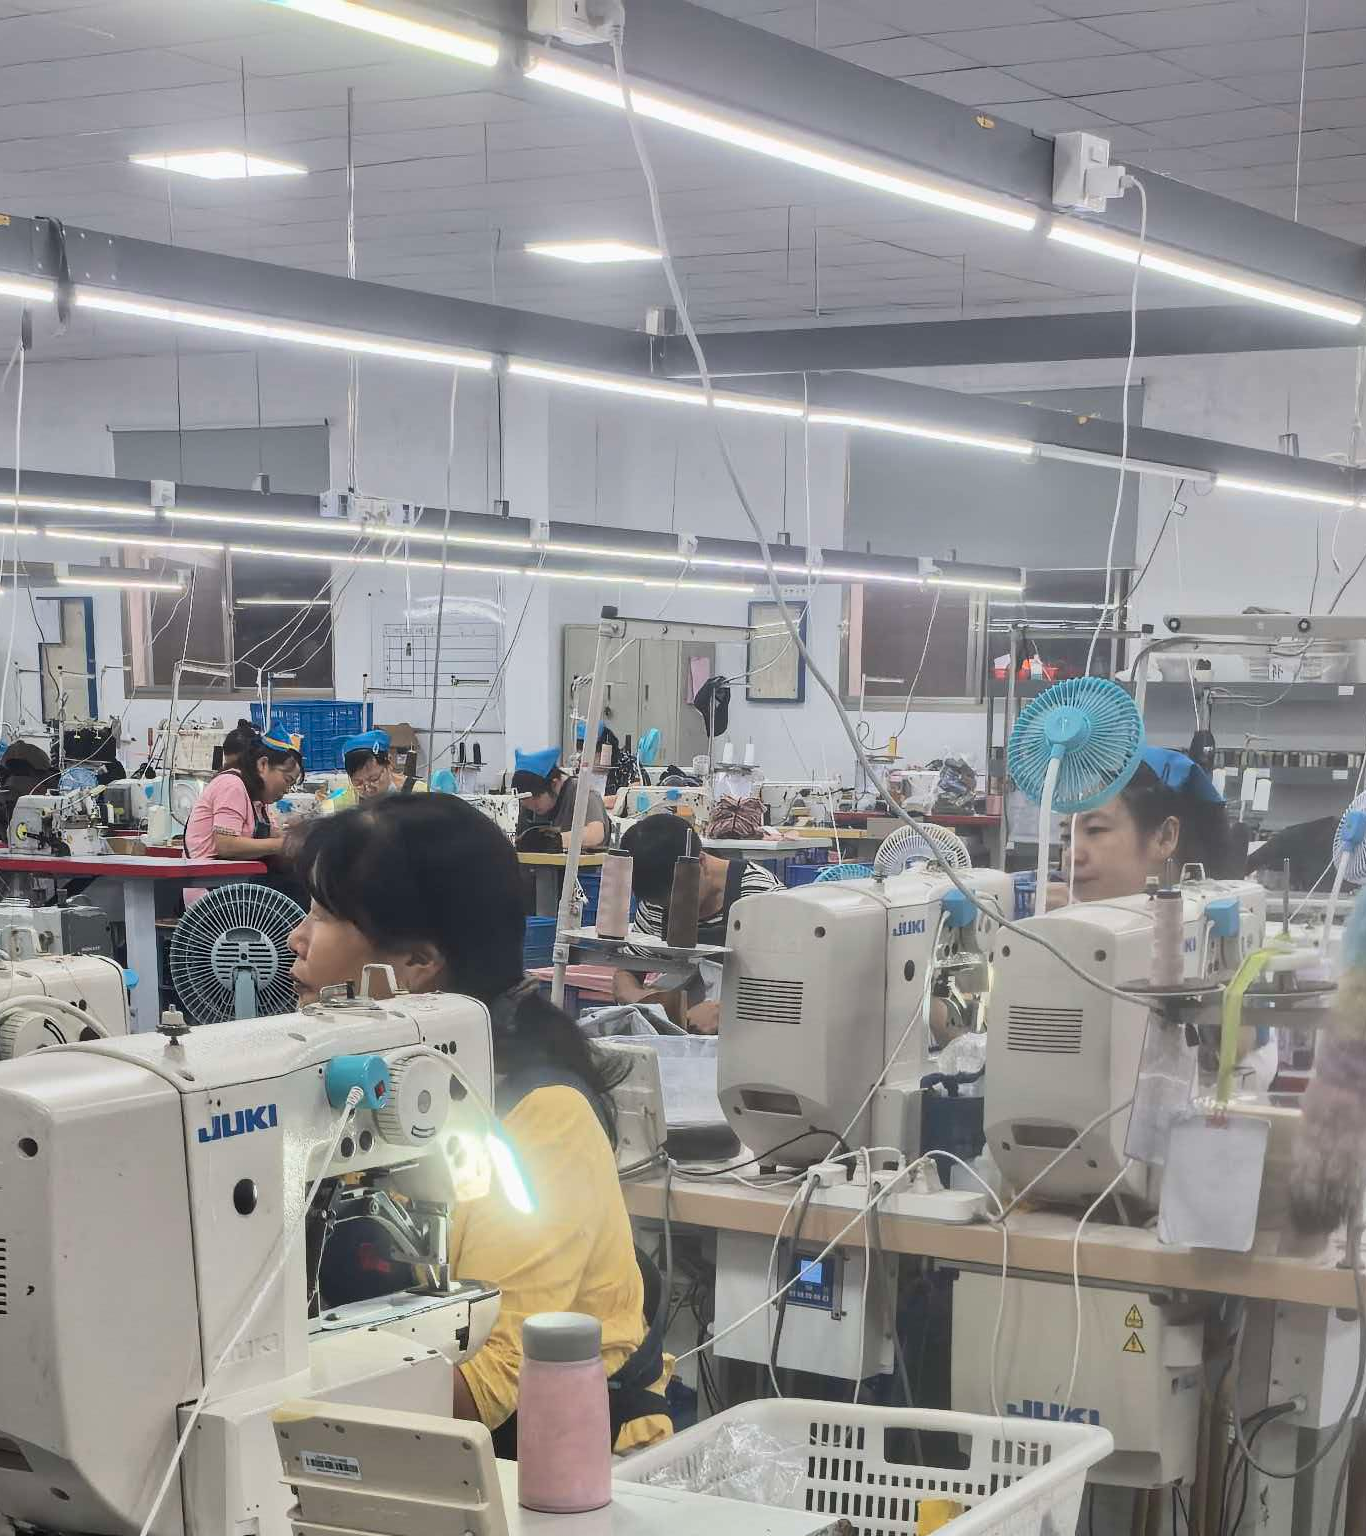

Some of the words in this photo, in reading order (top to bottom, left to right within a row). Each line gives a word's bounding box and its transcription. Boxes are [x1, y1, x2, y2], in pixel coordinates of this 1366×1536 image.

[892, 919, 925, 937] JUKI
[1184, 935, 1196, 953] KI
[198, 1103, 278, 1144] JUKI
[1006, 1399, 1100, 1426] JUKI
